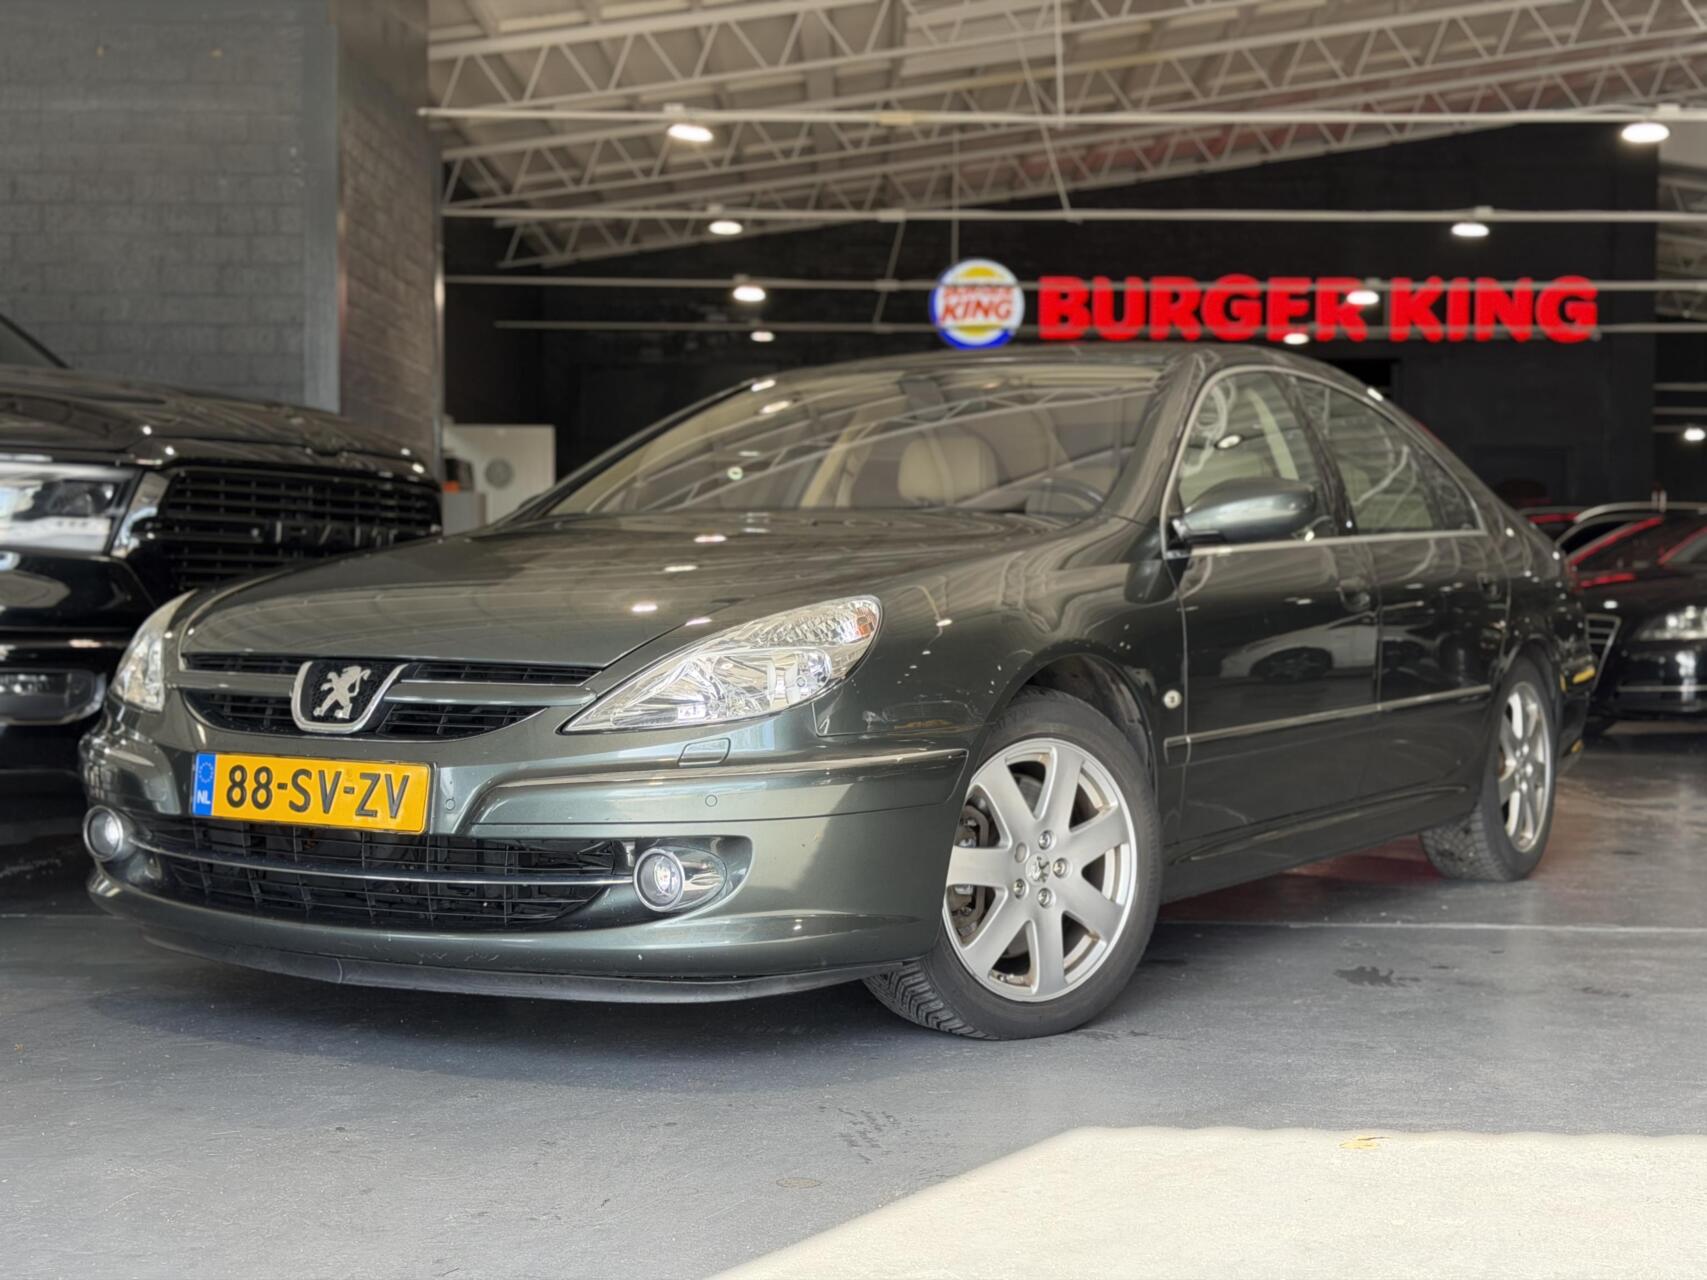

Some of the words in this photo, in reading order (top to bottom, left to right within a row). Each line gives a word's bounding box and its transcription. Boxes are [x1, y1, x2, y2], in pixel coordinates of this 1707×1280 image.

[940, 299, 1012, 322] KING
[1038, 274, 1368, 342] BURGER
[1388, 275, 1598, 343] KING
[197, 789, 211, 804] NL
[226, 764, 410, 819] 88-SV-ZV
